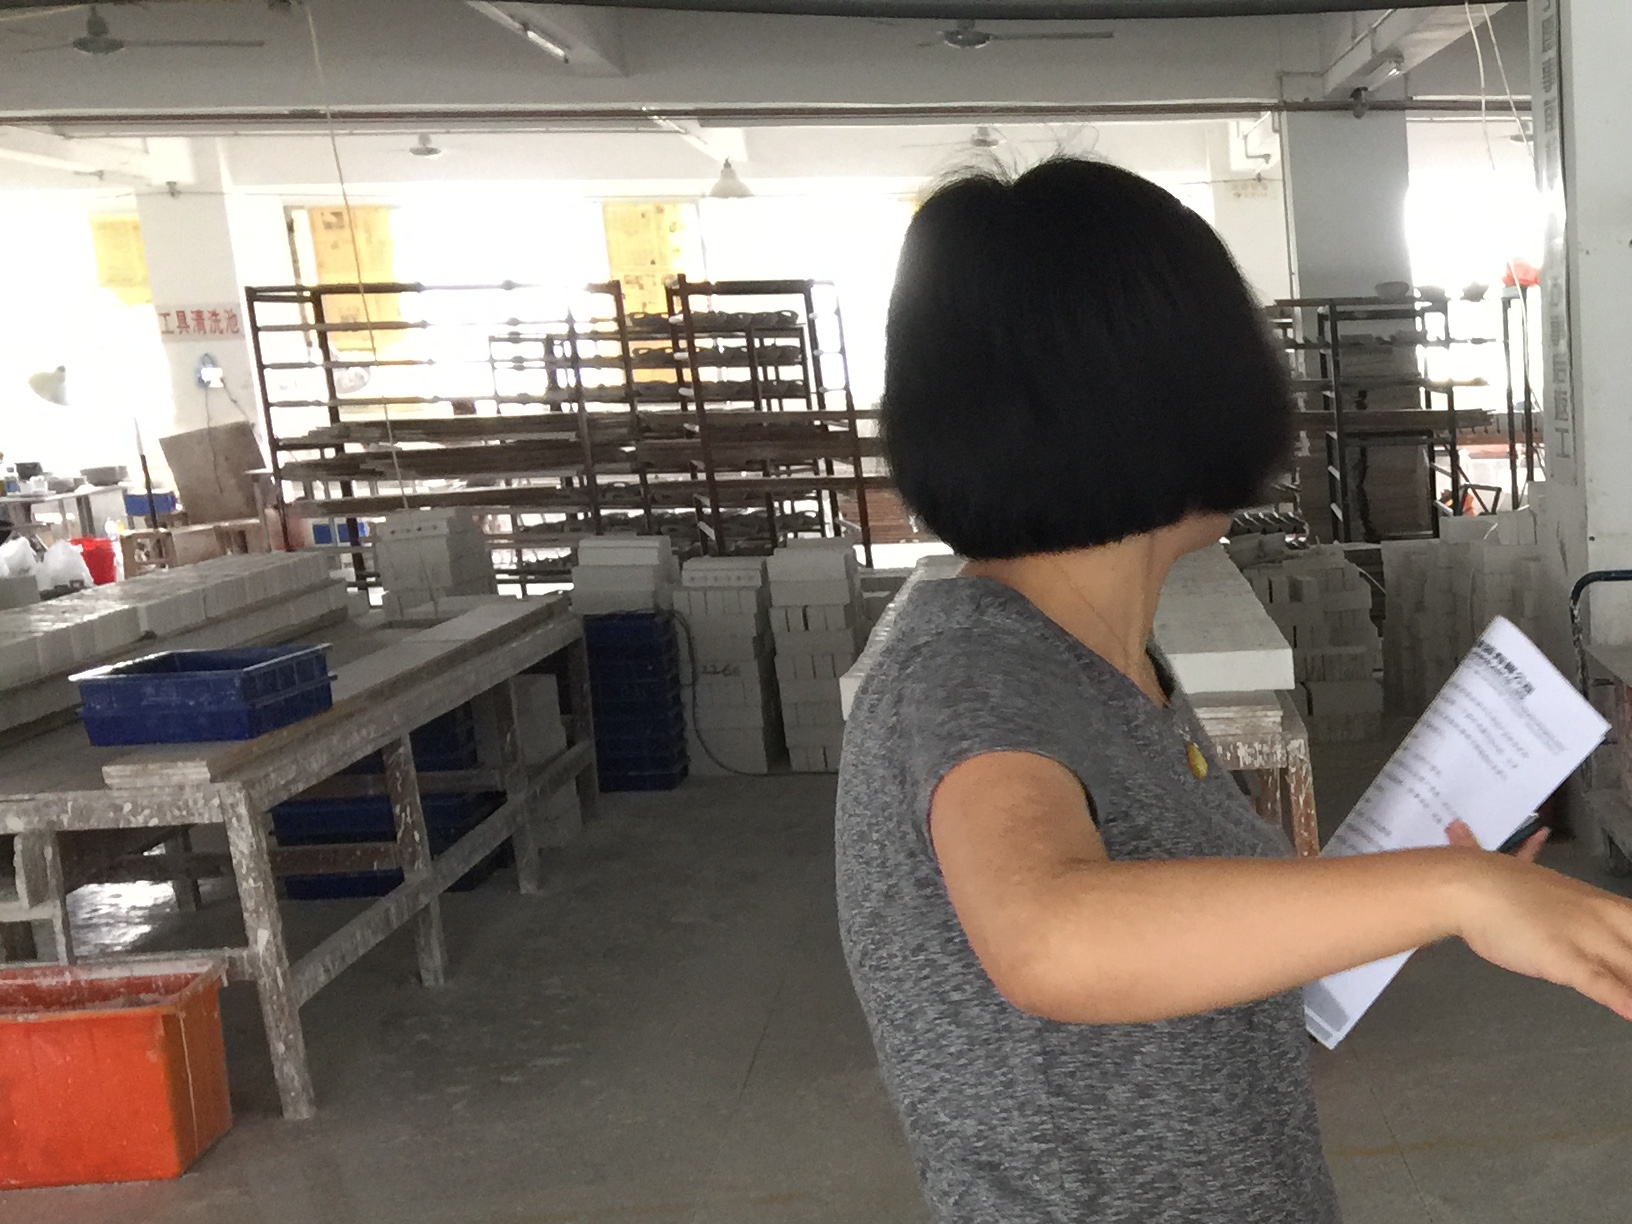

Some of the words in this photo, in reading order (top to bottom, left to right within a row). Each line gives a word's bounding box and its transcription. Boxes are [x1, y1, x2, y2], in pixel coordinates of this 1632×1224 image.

[158, 308, 240, 335] 工具清洗池
